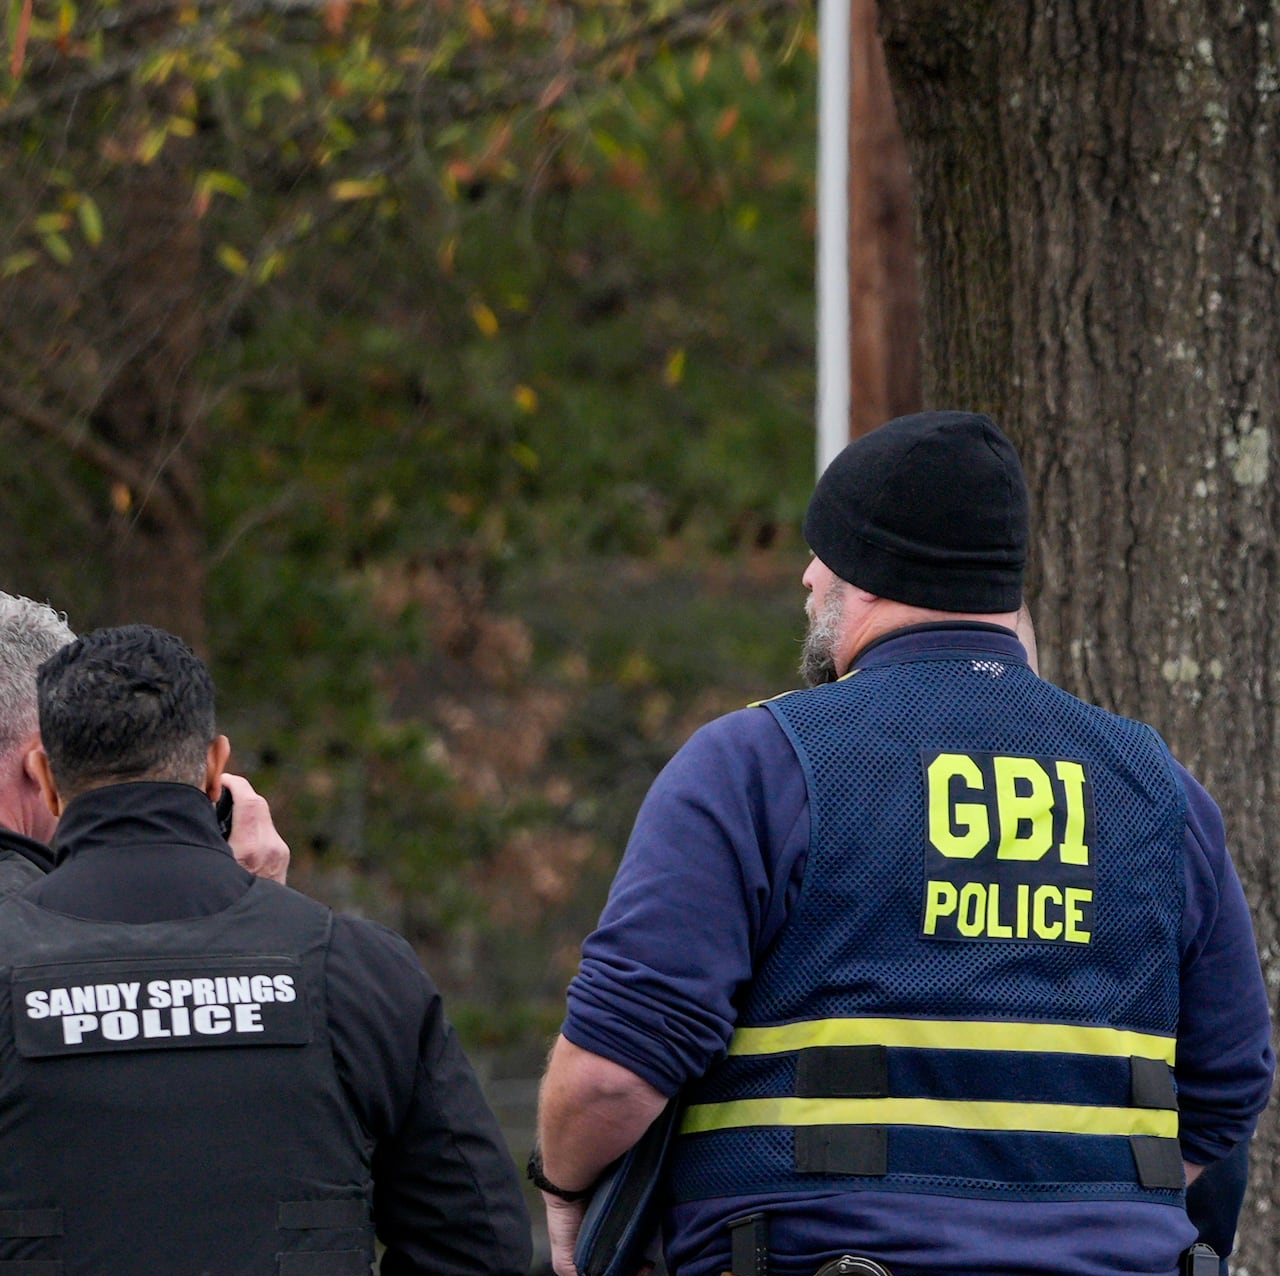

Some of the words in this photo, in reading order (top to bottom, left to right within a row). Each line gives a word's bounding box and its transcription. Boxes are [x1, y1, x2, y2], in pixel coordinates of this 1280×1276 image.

[927, 753, 1090, 866] GBI
[923, 880, 1093, 945] POLICE
[25, 981, 141, 1020] SANDY
[146, 974, 297, 1009] SPRINGS
[61, 1002, 265, 1045] POLICE
